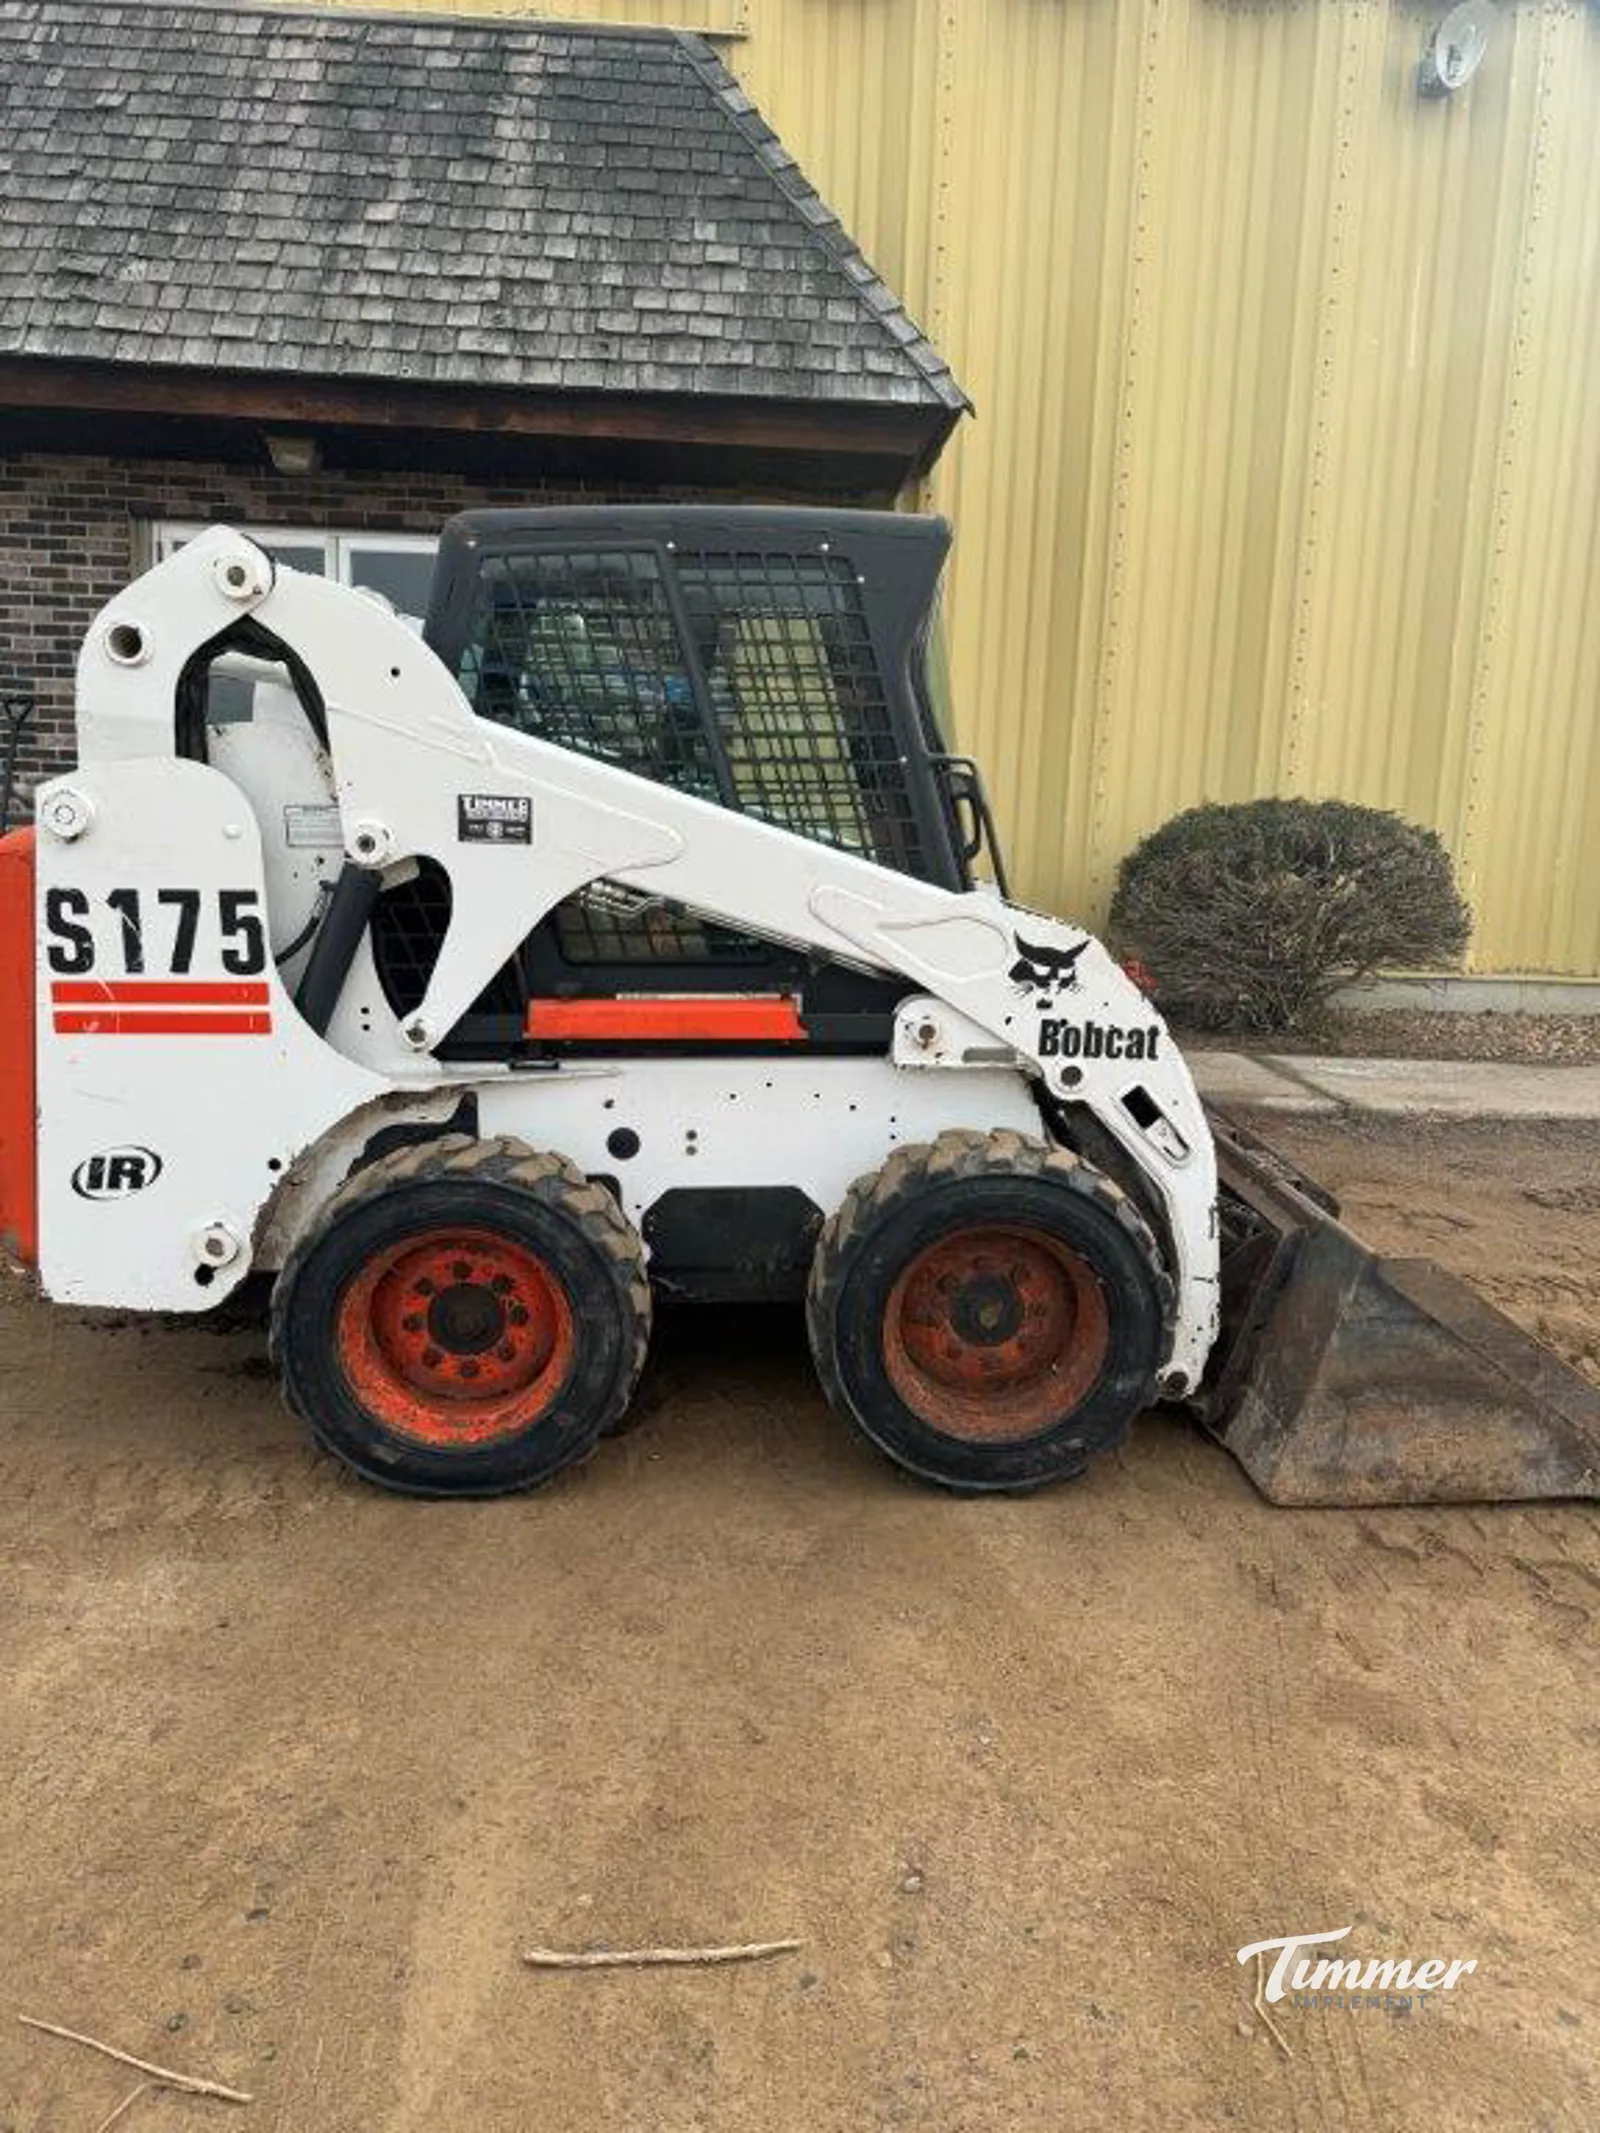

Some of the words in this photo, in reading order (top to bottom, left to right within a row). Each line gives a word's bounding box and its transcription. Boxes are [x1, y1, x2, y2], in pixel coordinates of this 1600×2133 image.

[46, 888, 266, 975] S175
[1038, 1019, 1161, 1061] Bobcat
[86, 1157, 145, 1190] IR
